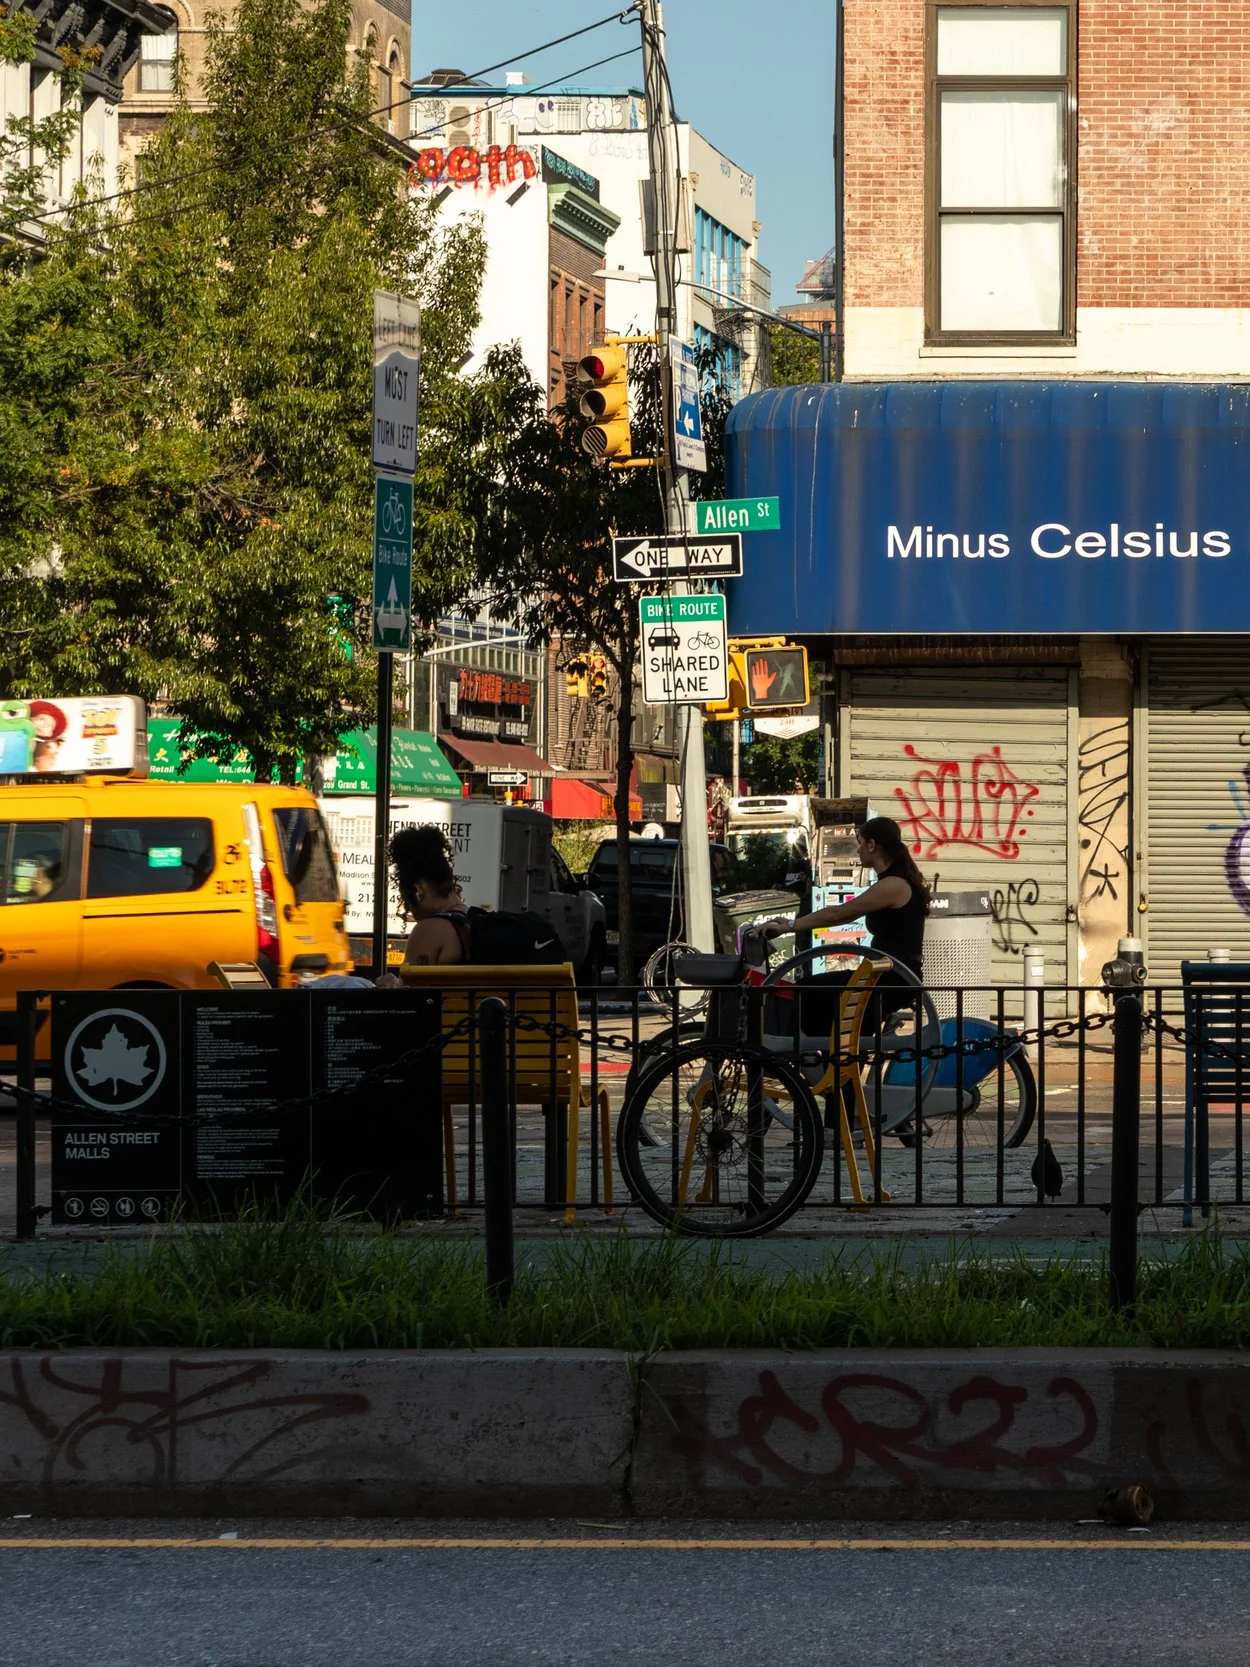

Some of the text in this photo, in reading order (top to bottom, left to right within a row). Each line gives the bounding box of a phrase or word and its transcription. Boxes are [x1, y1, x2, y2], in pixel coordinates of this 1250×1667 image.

[384, 366, 408, 402] MUST
[377, 418, 414, 451] TURN LEFT
[704, 502, 770, 529] Allen St
[887, 525, 1011, 559] Minus
[1030, 522, 1232, 559] Celsius
[378, 545, 408, 567] Bike Route
[634, 547, 724, 567] ONE WAY
[647, 602, 718, 617] BIKE ROUTE
[650, 655, 720, 693] SHARED LANE
[150, 765, 175, 774] Retail
[338, 780, 357, 790] Grand
[360, 780, 370, 790] St.
[342, 853, 375, 865] MEAL
[339, 871, 370, 879] Madison
[64, 1132, 160, 1145] ALLEN STREET
[65, 1147, 111, 1159] MALLS
